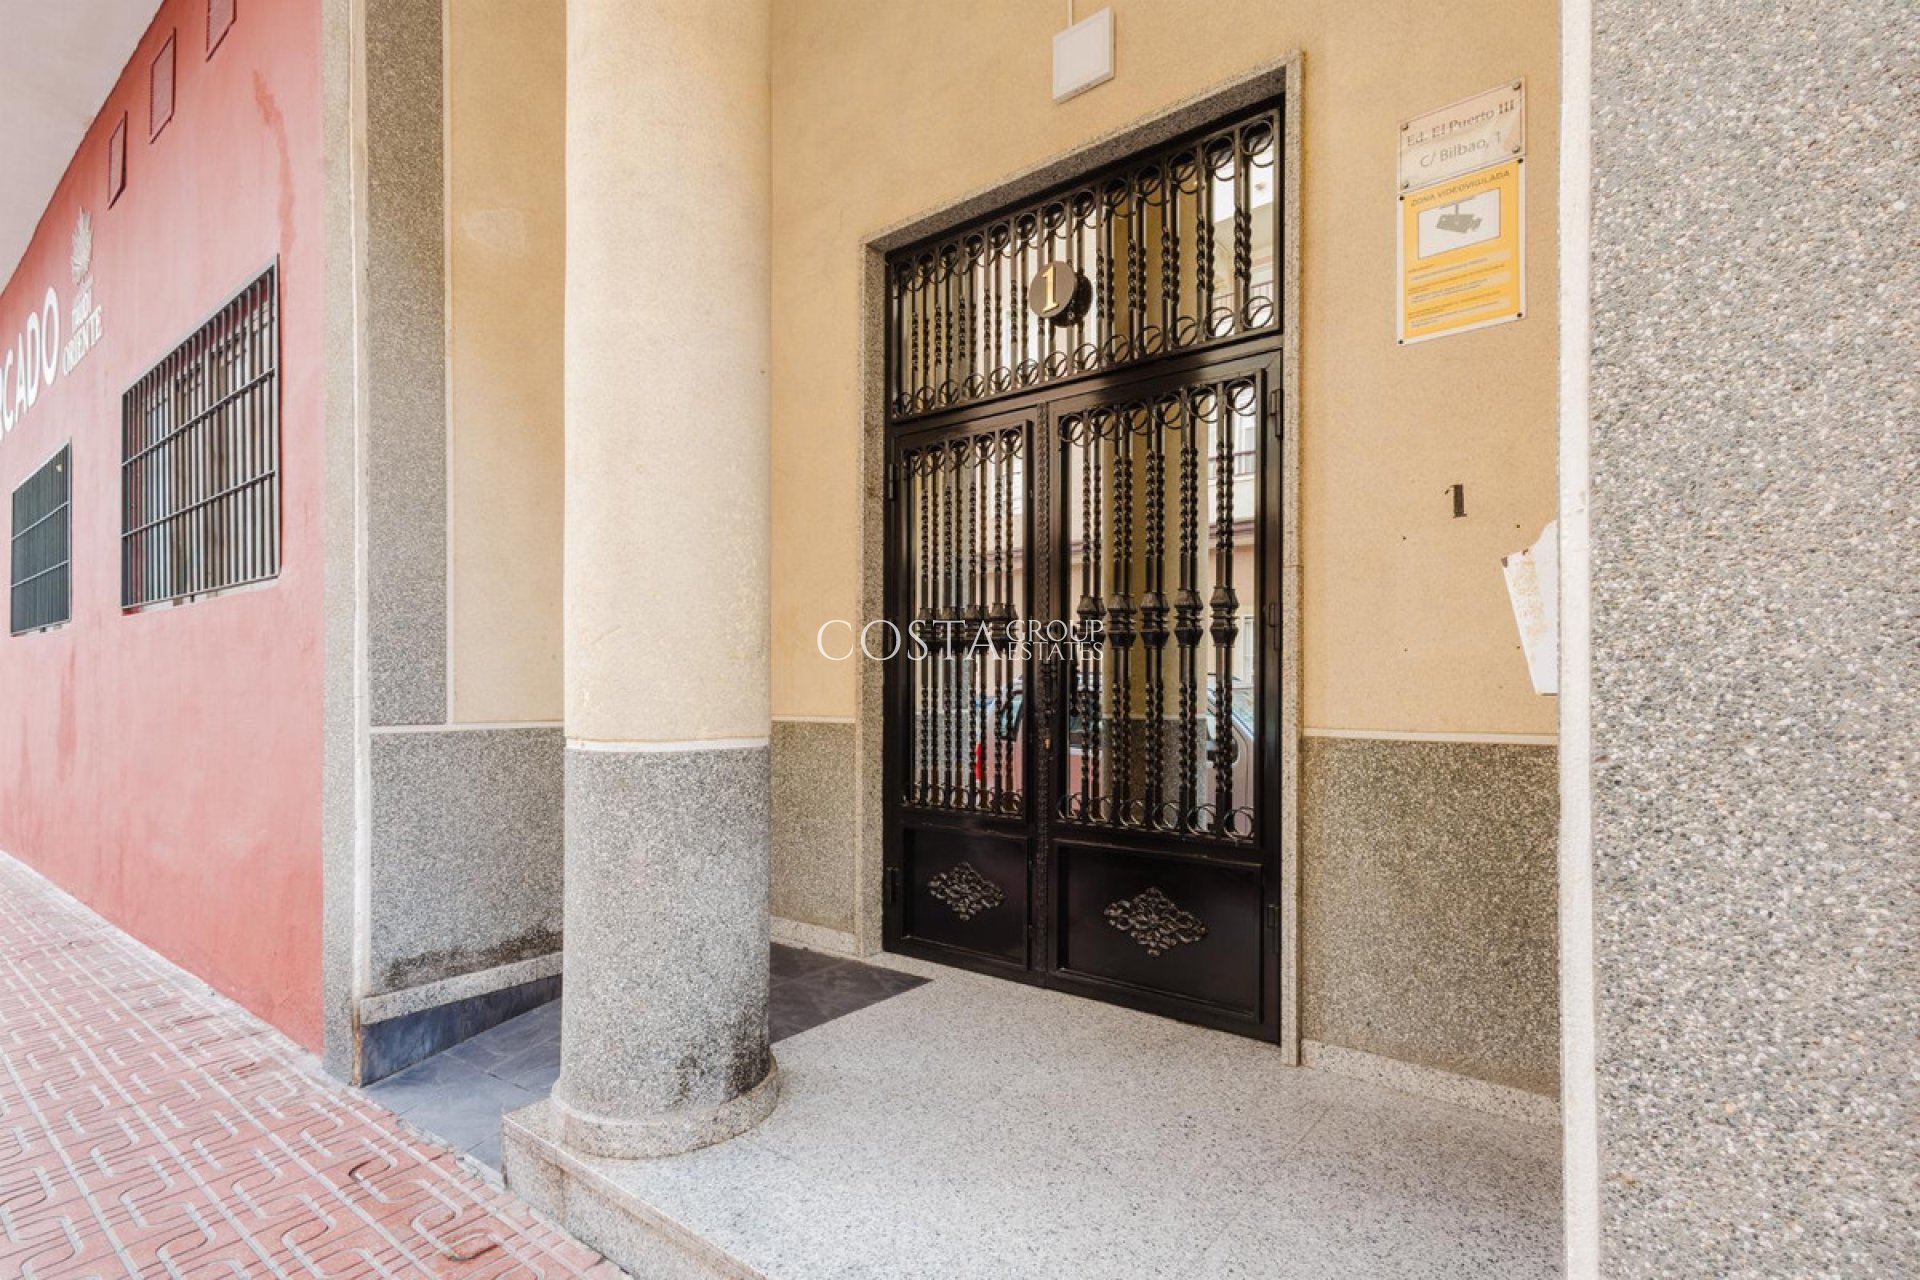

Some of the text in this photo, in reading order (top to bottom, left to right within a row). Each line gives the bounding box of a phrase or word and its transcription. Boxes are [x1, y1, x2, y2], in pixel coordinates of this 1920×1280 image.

[1431, 125, 1446, 139] El
[1449, 110, 1494, 133] Puerto
[1498, 100, 1515, 115] III
[1420, 131, 1501, 168] C/ Bilbao, 1
[1410, 170, 1510, 207] ZONA VIDEOVIGILADA
[1042, 265, 1059, 313] 1
[0, 287, 59, 441] CADO
